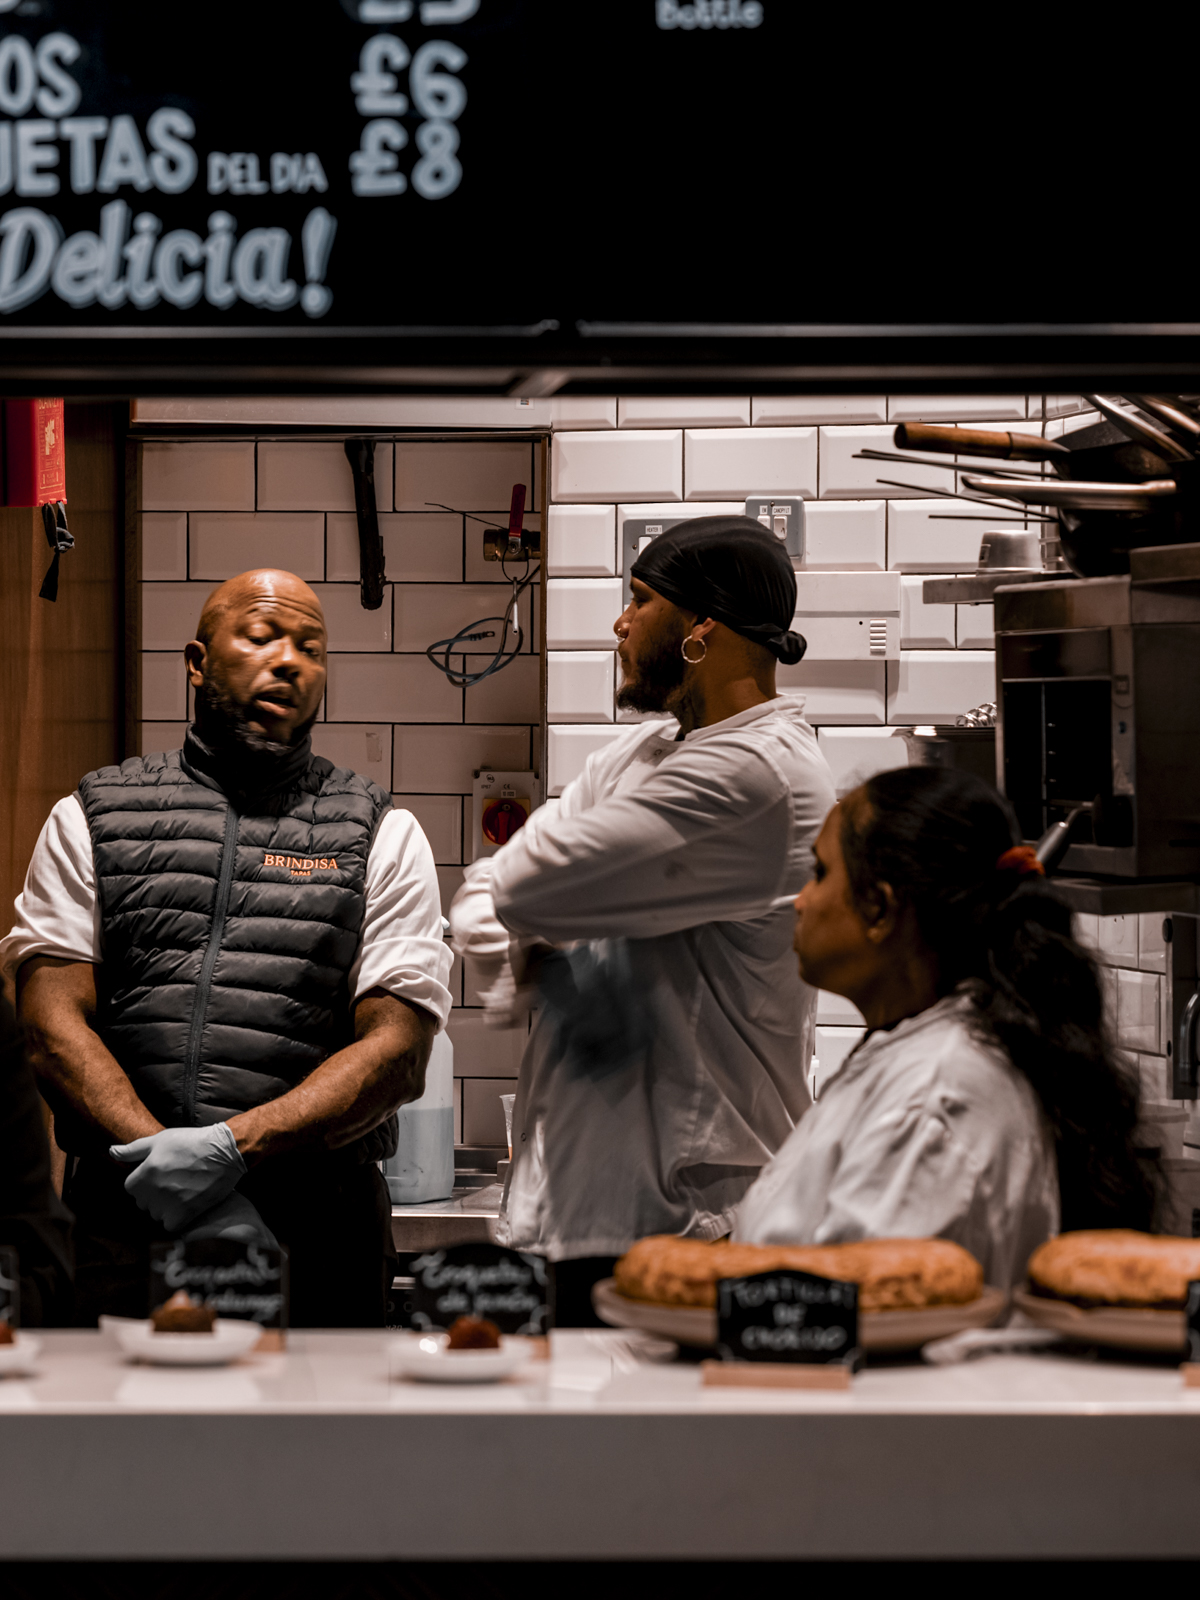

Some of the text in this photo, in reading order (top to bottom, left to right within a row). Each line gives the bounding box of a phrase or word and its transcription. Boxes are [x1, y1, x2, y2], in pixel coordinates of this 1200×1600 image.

[351, 33, 468, 120] £6
[207, 151, 269, 195] DEL
[270, 152, 328, 194] DIA
[349, 118, 462, 200] £8
[263, 854, 338, 870] BRINDISA
